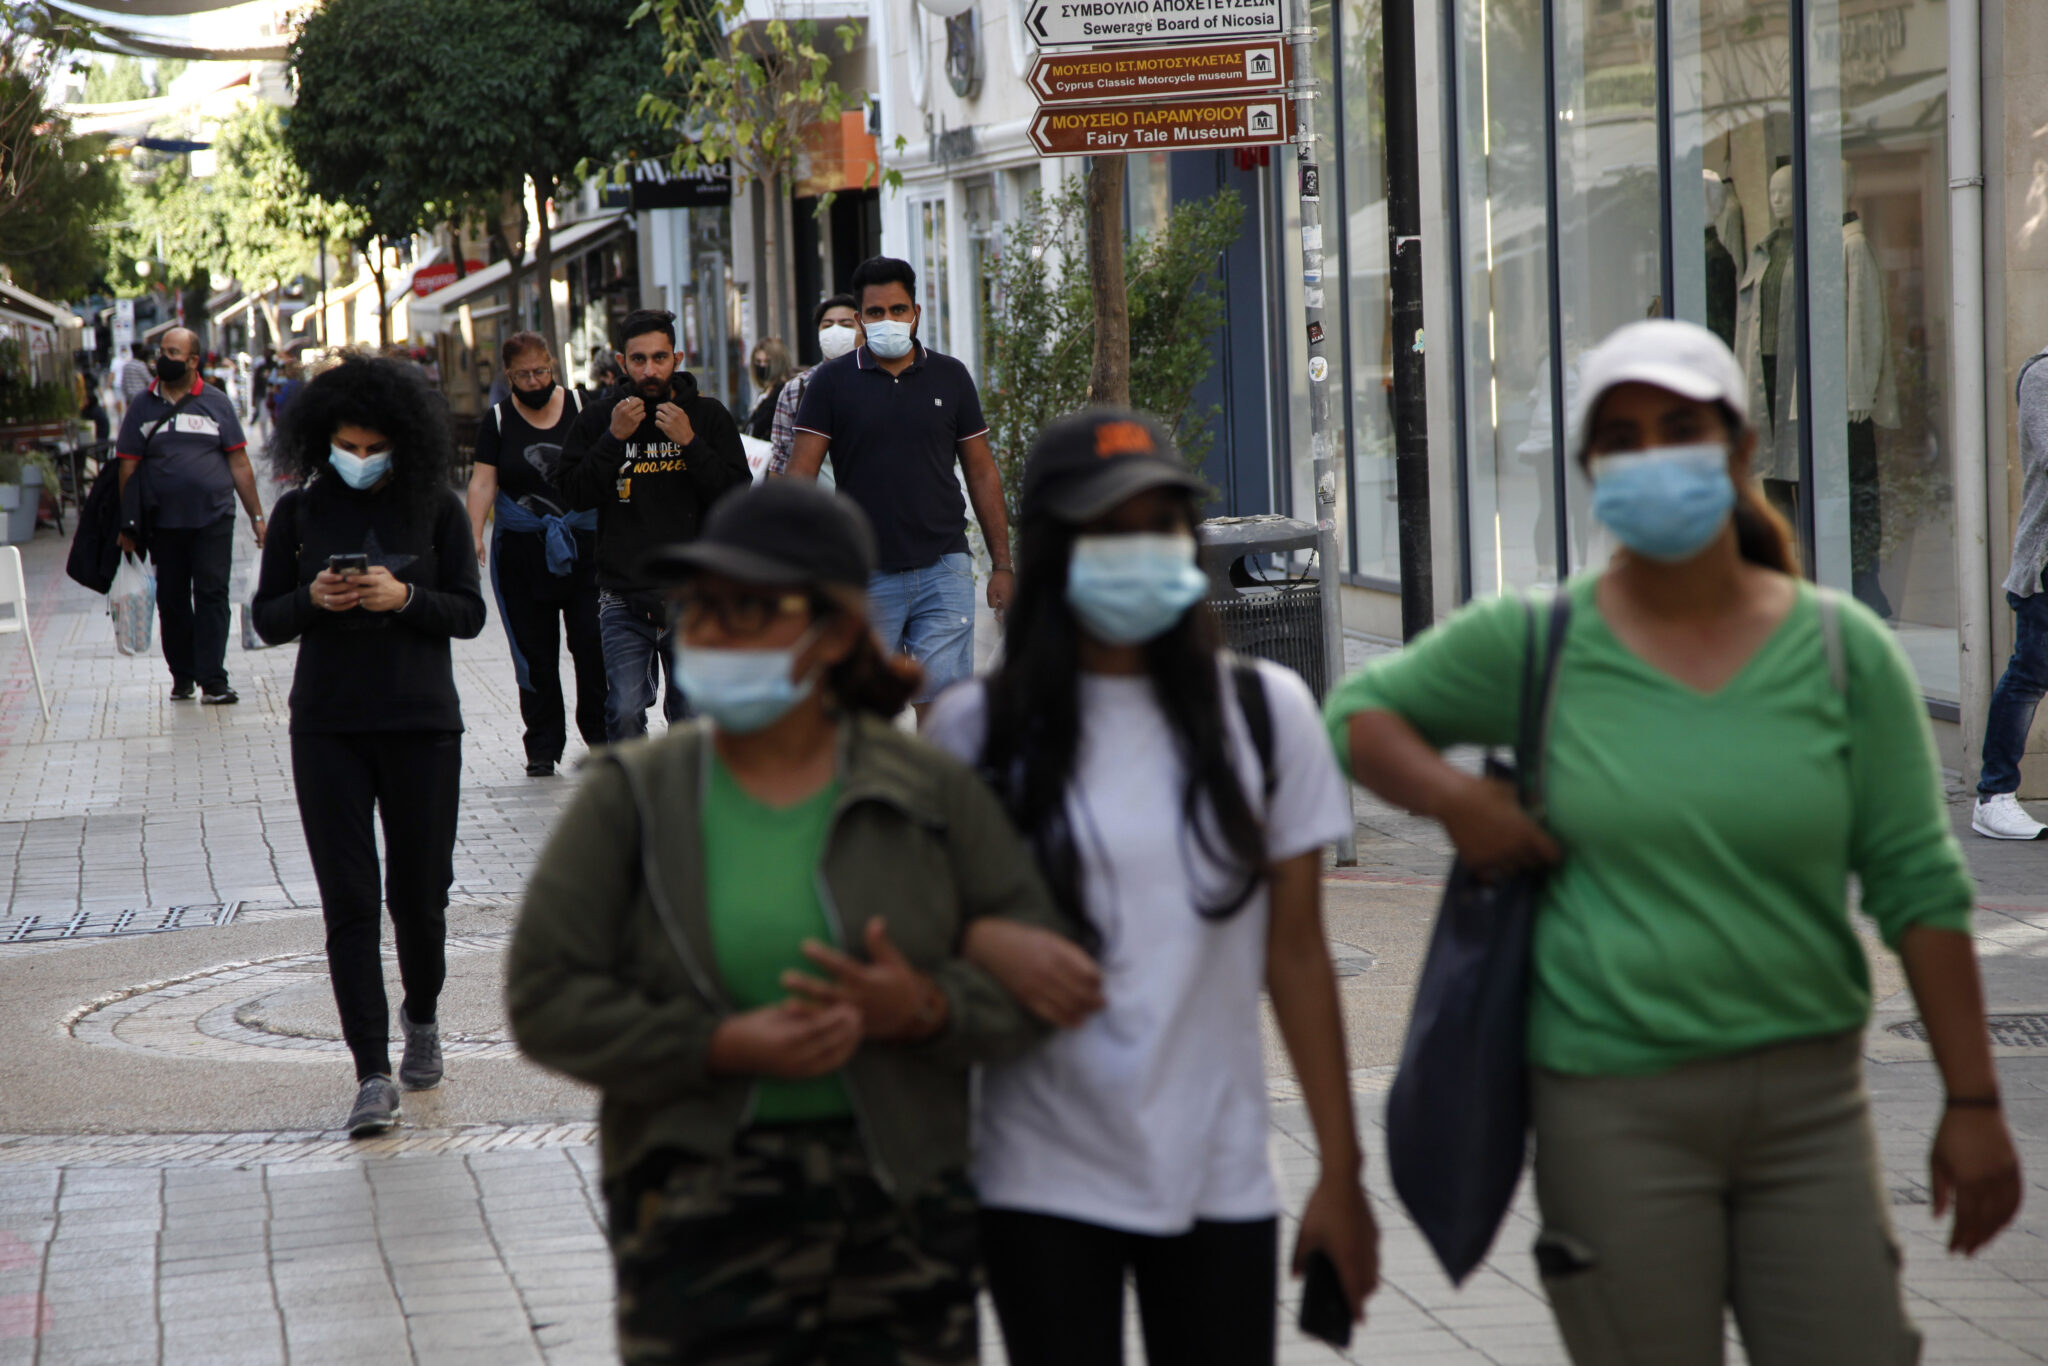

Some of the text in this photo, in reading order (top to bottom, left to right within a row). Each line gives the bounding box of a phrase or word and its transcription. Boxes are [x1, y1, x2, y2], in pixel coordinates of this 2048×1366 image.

[1061, 1, 1149, 17] ΣΥΜΒΟΥΛΙΟ
[1083, 12, 1274, 36] Sewerage Board of Nicosia
[1052, 53, 1243, 77] ΜΟΥΣΕΙΟ ΙΣΤ.ΜΟΤΟΣΥΚΛΕΤΑΣ
[1056, 70, 1243, 93] Cyprus Classic Motorcycle museum
[1052, 105, 1245, 129] ΜΟΥΣΕΙΟ ΠΑΡΑΜΥΘΙΟΥ
[1086, 125, 1245, 147] Fairy Tale Museum
